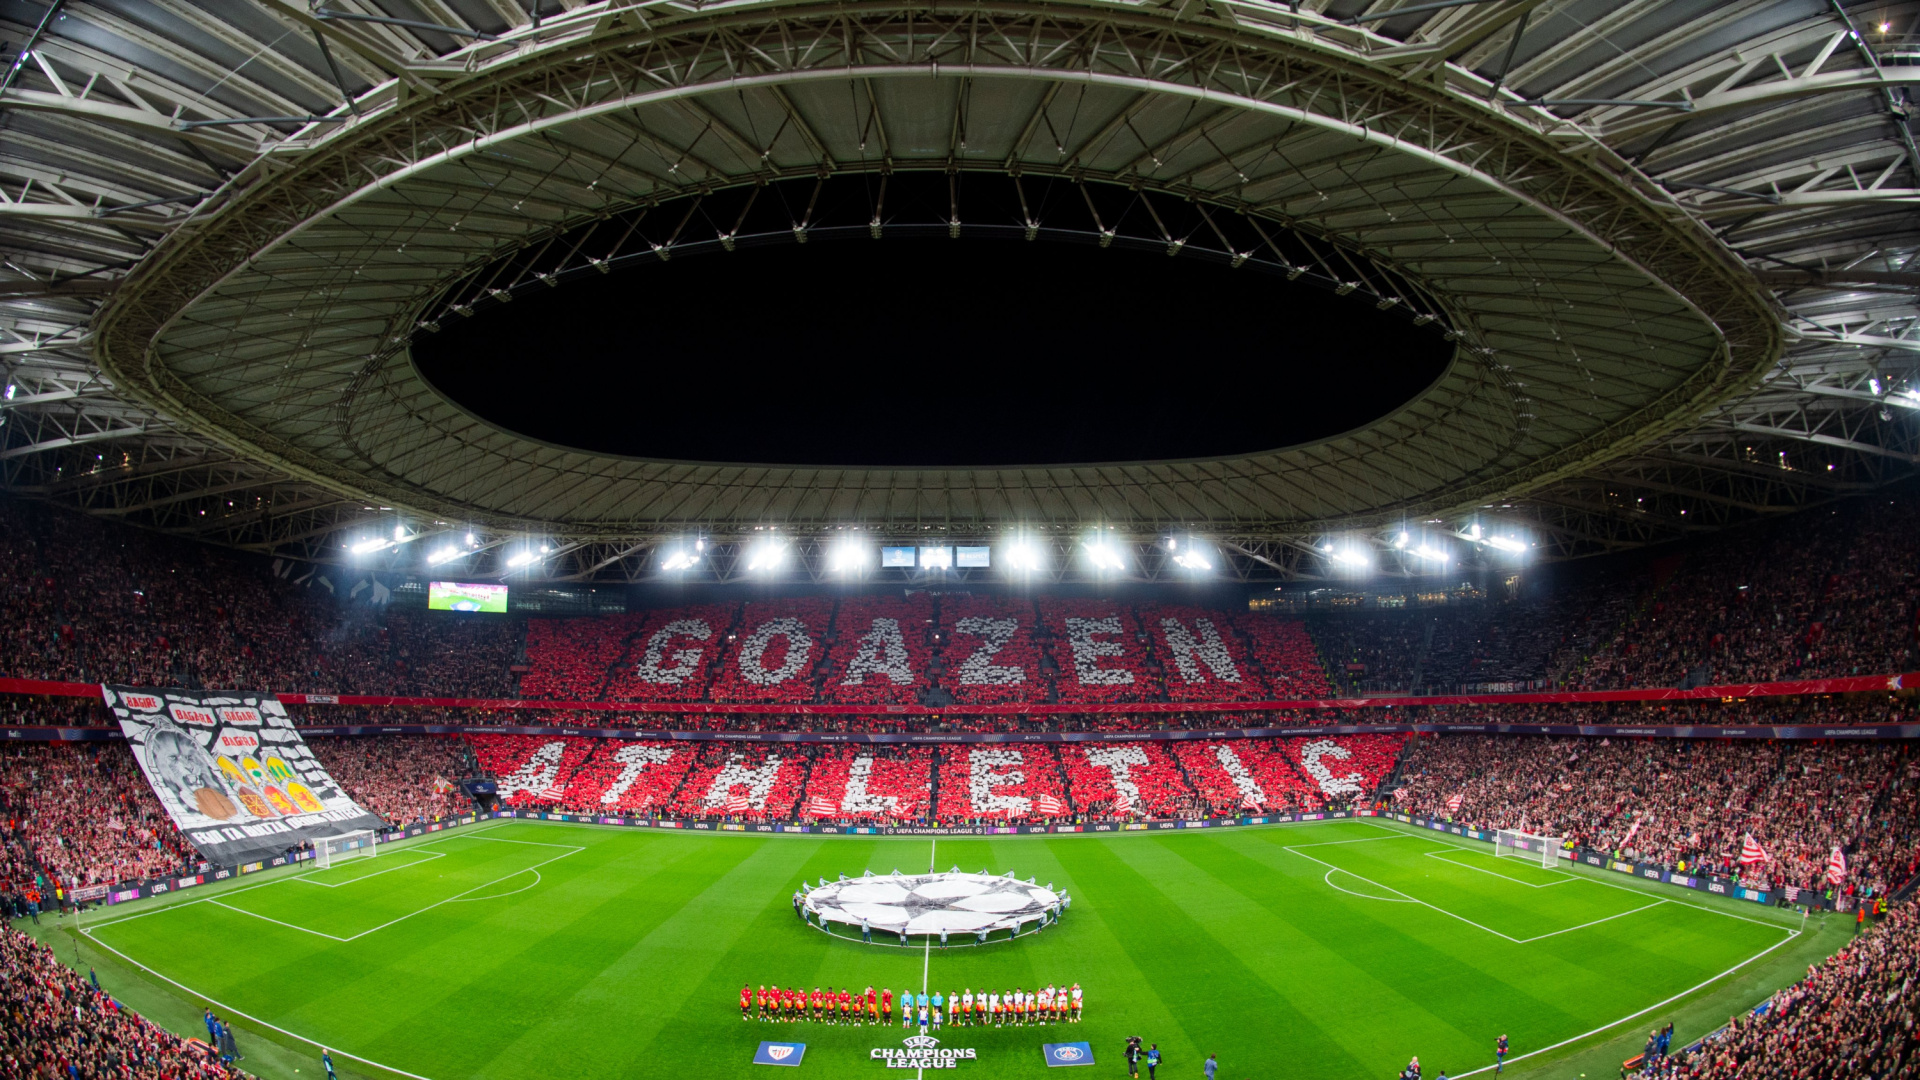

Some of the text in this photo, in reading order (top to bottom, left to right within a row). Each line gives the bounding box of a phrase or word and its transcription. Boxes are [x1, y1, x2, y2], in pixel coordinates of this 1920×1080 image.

[637, 616, 1242, 686] GOAZEN
[1488, 683, 1513, 692] PARIS
[126, 696, 157, 708] BAGIRE
[496, 739, 1365, 813] ATHLETIC
[221, 827, 247, 841] TA
[240, 821, 293, 838] BULTZA
[272, 857, 286, 866] UEFA
[1587, 856, 1600, 865] UEFA
[215, 870, 230, 880] UEFA
[1644, 869, 1659, 879] UEFA
[151, 883, 168, 894] UEFA
[1708, 882, 1725, 893] UEFA
[904, 1037, 937, 1048] UEFA
[870, 1048, 977, 1058] CHAMPIONS
[886, 1058, 957, 1068] LEAGUE
